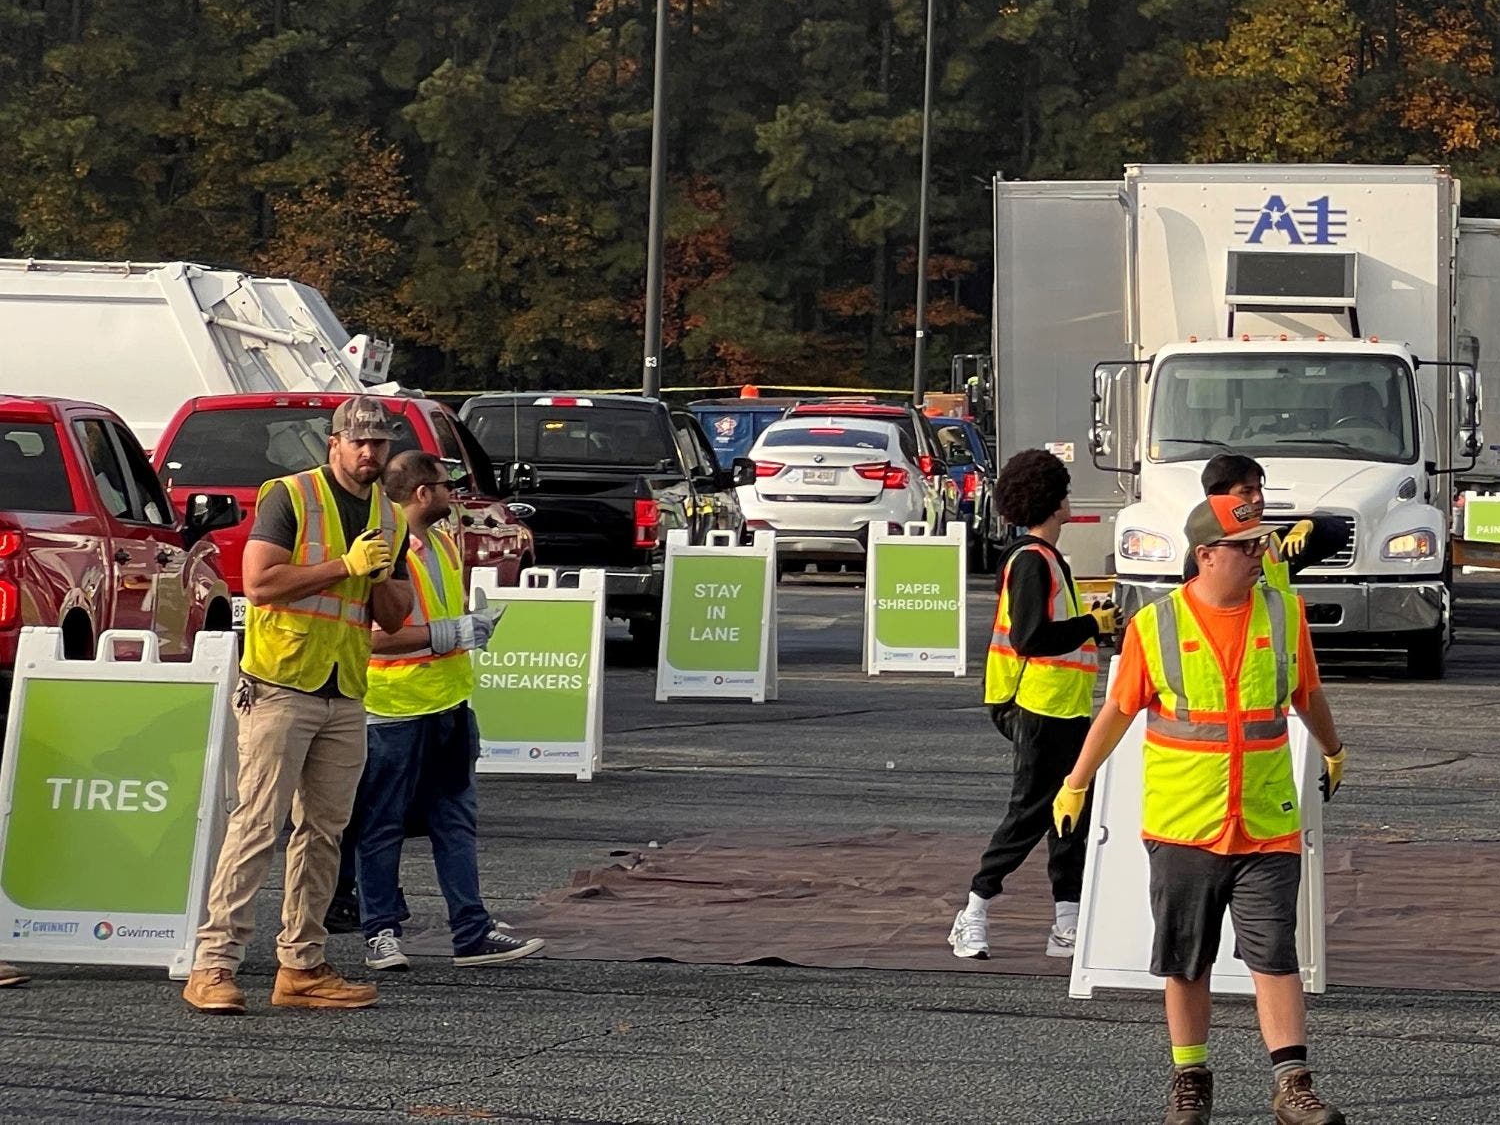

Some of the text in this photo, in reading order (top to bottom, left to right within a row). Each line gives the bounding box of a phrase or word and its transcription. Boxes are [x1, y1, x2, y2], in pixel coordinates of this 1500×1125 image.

[1244, 194, 1338, 245] A1
[695, 583, 742, 598] STAY
[895, 583, 941, 595] PAPER
[878, 598, 958, 611] SHREDDING
[706, 605, 726, 620] IN
[690, 626, 740, 642] LANE
[479, 651, 587, 668] CLOTHING/
[479, 673, 583, 690] SNEAKERS
[46, 777, 170, 813] TIRES
[32, 921, 80, 934] GWINNETT
[116, 925, 176, 939] Gwinnett
